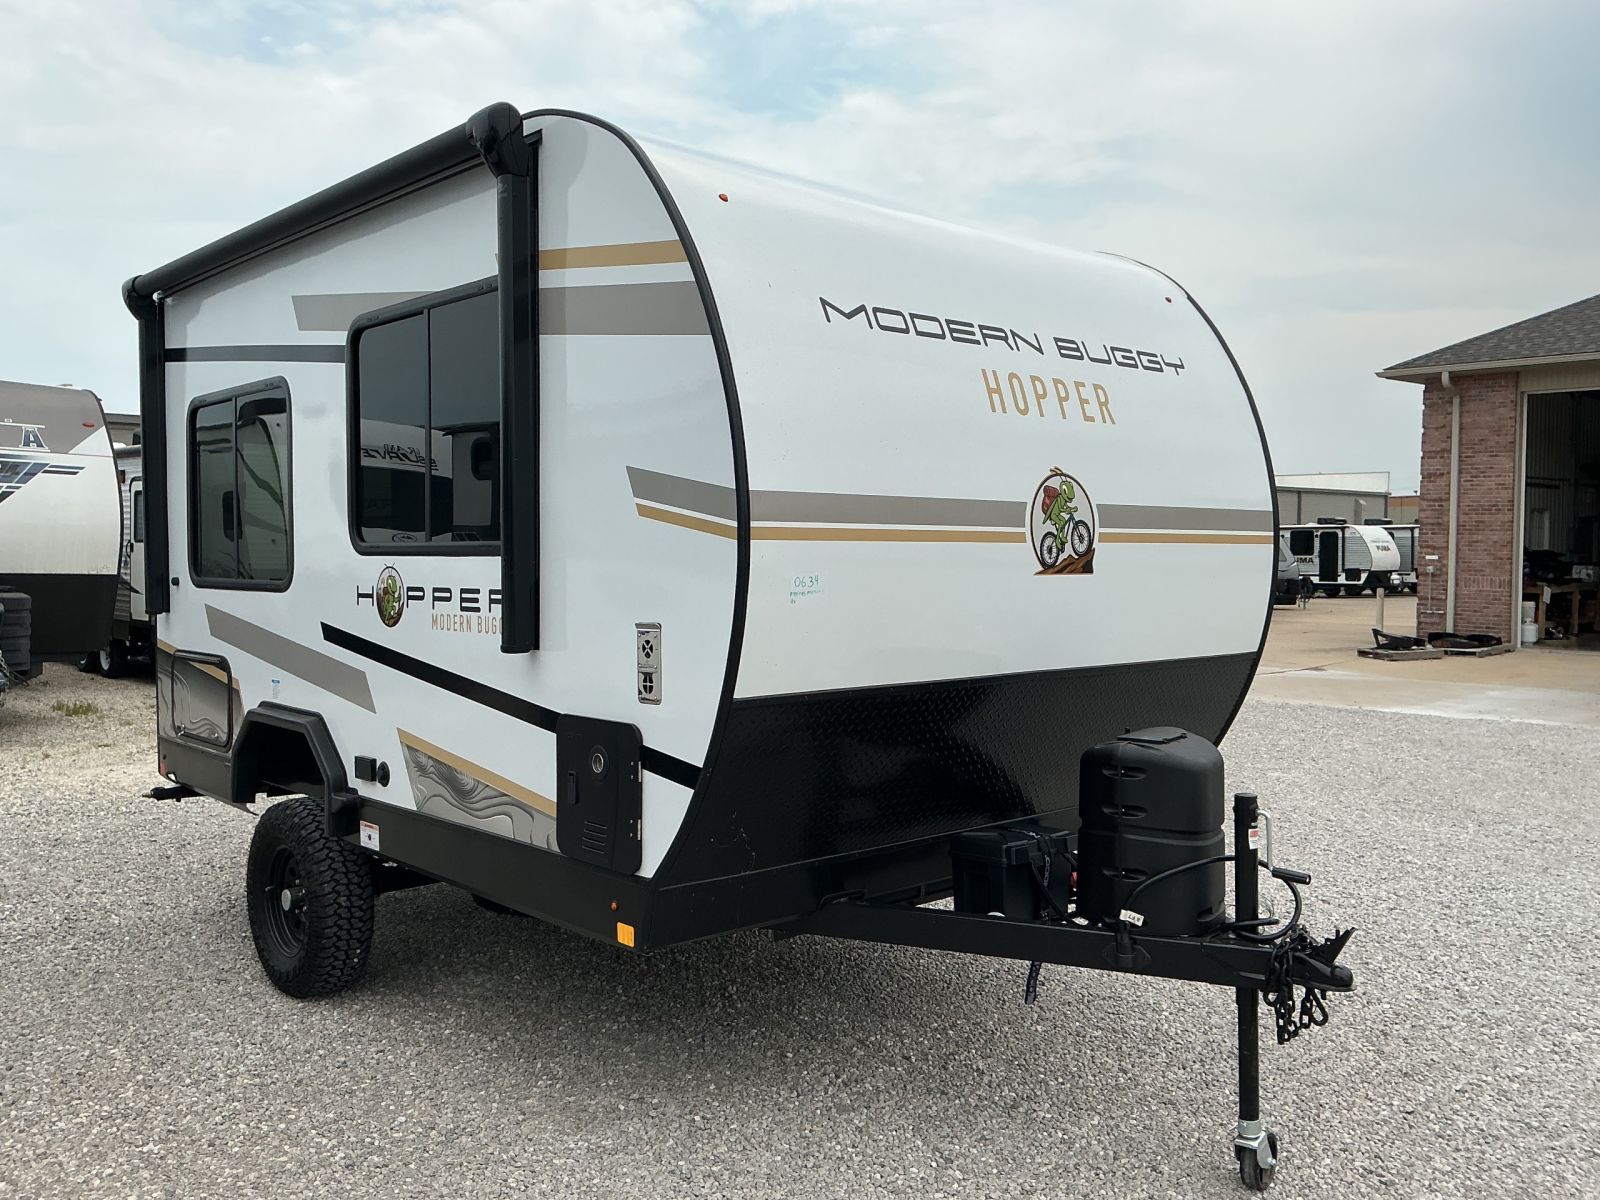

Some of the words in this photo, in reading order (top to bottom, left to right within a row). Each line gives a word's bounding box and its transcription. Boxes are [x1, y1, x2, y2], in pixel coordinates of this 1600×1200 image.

[819, 296, 1044, 356] MODERN
[1053, 336, 1185, 376] BUGGY
[981, 368, 1116, 425] HOPPER
[793, 575, 819, 588] 0634
[431, 613, 472, 633] MODERN
